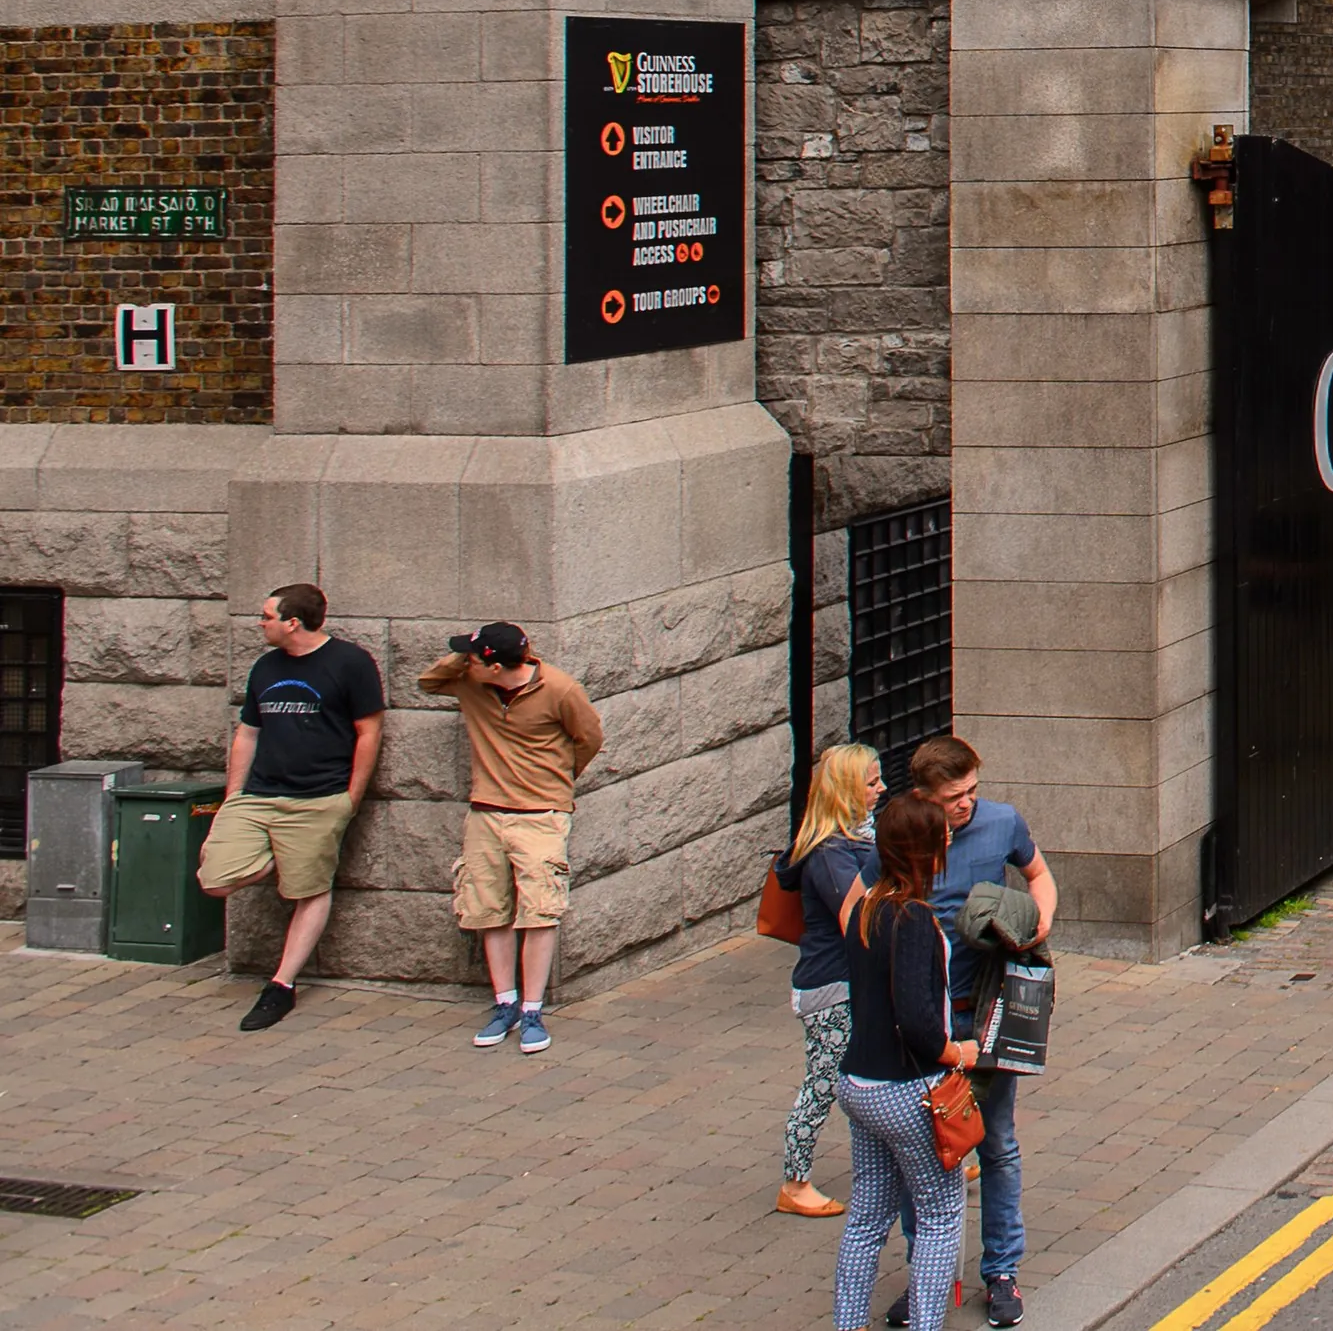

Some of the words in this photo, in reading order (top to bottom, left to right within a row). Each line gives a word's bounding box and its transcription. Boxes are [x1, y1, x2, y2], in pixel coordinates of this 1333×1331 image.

[637, 51, 696, 73] GUINNESS
[637, 73, 713, 94] STOREHOUSE
[632, 126, 675, 145] VISITOR
[632, 150, 687, 170] ENTRANCE
[632, 194, 700, 216] WHEELCHAIR
[75, 216, 138, 231] MARKET
[632, 221, 656, 241] AND
[658, 217, 717, 239] PUSHCHAIR
[632, 245, 675, 266] ACCESS
[632, 290, 662, 312] TOUR
[664, 286, 707, 308] GROUPS
[123, 309, 169, 365] H
